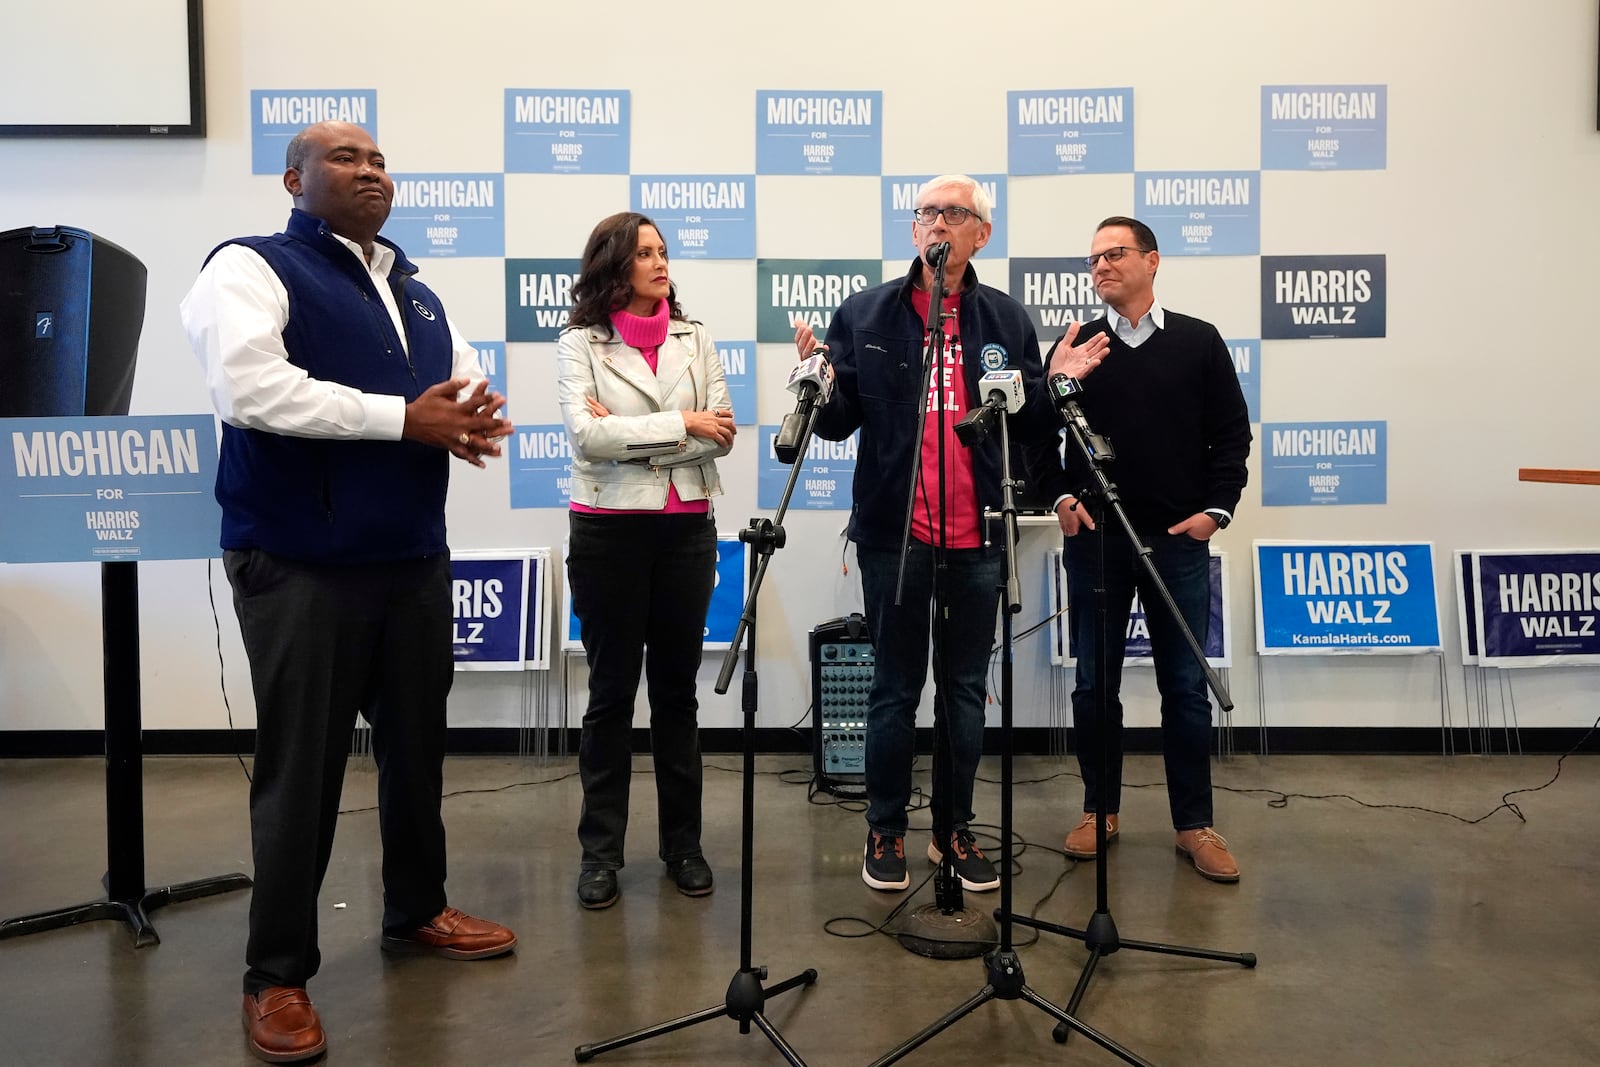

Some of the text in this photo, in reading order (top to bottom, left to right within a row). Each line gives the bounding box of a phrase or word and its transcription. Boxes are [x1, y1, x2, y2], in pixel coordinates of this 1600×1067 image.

[262, 97, 366, 125] MICHIGAN
[516, 96, 619, 124] MICHIGAN
[768, 98, 871, 125] MICHIGAN
[1019, 96, 1122, 124] MICHIGAN
[1272, 93, 1375, 119] MICHIGAN
[559, 130, 576, 138] FOR
[811, 131, 828, 139] FOR
[1063, 130, 1079, 138] FOR
[1315, 126, 1332, 134] FOR
[552, 144, 583, 155] HARRIS
[804, 145, 835, 155] HARRIS
[1056, 144, 1087, 156] HARRIS
[1308, 140, 1340, 151] HARRIS
[391, 181, 494, 207] MICHIGAN
[642, 182, 744, 209] MICHIGAN
[1146, 179, 1249, 205] MICHIGAN
[433, 214, 451, 222] FOR
[685, 215, 702, 223] FOR
[1189, 212, 1206, 220] FOR
[427, 228, 458, 240] HARRIS
[678, 229, 709, 241] HARRIS
[1182, 226, 1213, 237] HARRIS
[520, 274, 581, 307] HAR
[1024, 273, 1103, 305] HARR
[1276, 270, 1371, 303] HARRIS
[536, 310, 570, 327] WA
[788, 311, 831, 328] WAL
[1292, 307, 1355, 324] WALZ
[519, 432, 573, 459] MICH
[1273, 429, 1375, 456] MICHIGAN
[13, 429, 199, 476] MICHIGAN
[812, 466, 829, 474] FOR
[1316, 462, 1333, 470] FOR
[806, 480, 836, 490] HARRIS
[1309, 476, 1340, 487] HARRIS
[1313, 486, 1336, 494] WALZ
[97, 489, 123, 499] FOR
[86, 511, 139, 529] HARRIS
[96, 530, 133, 540] WALZ
[1283, 552, 1408, 595] HARRIS
[452, 579, 503, 618] RIS
[1307, 601, 1392, 624] WALZ
[453, 623, 484, 643] LZ
[1520, 616, 1595, 637] WALZ
[1293, 633, 1412, 645] KamalaHarris.com
